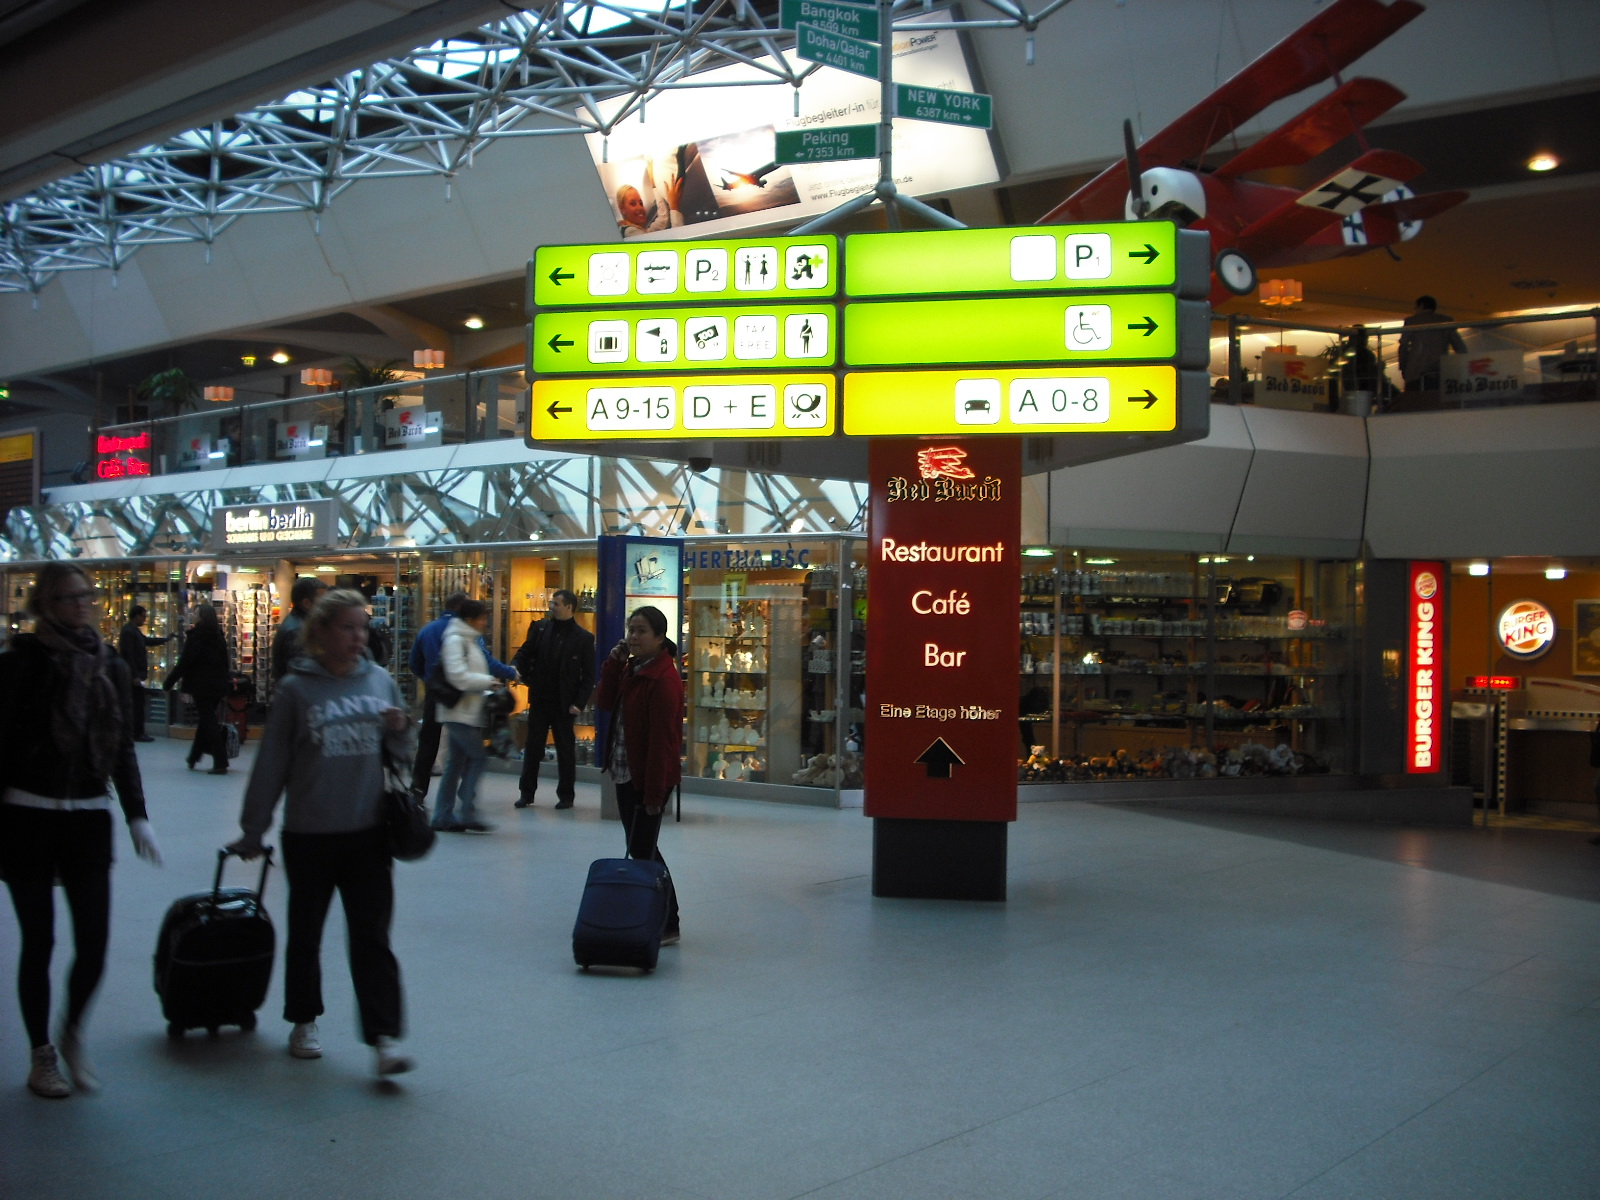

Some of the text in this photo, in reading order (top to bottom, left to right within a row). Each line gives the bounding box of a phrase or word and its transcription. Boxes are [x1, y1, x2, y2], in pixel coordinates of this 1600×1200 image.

[801, 2, 860, 22] Bangkok
[841, 23, 859, 36] km
[807, 30, 871, 59] Doha/Qatar
[826, 52, 865, 71] 4401 km
[907, 89, 980, 110] NEW YORK
[916, 106, 960, 120] 6387 km
[802, 130, 850, 146] Peking
[807, 146, 855, 158] 7353 km
[745, 325, 766, 333] TAX
[591, 397, 670, 420] A 9-15
[693, 396, 711, 419] D
[751, 395, 767, 418] E
[1018, 388, 1098, 412] A 0-8
[887, 476, 930, 502] Red
[685, 548, 810, 570] HERTHA BSC
[881, 538, 1005, 562] Restaurant
[911, 589, 971, 615] Café
[1503, 610, 1547, 631] BURGER
[1503, 621, 1547, 648] KING
[924, 643, 967, 667] Bar
[1414, 601, 1435, 768] BURGER KING
[880, 703, 1002, 722] Eine Etage höher
